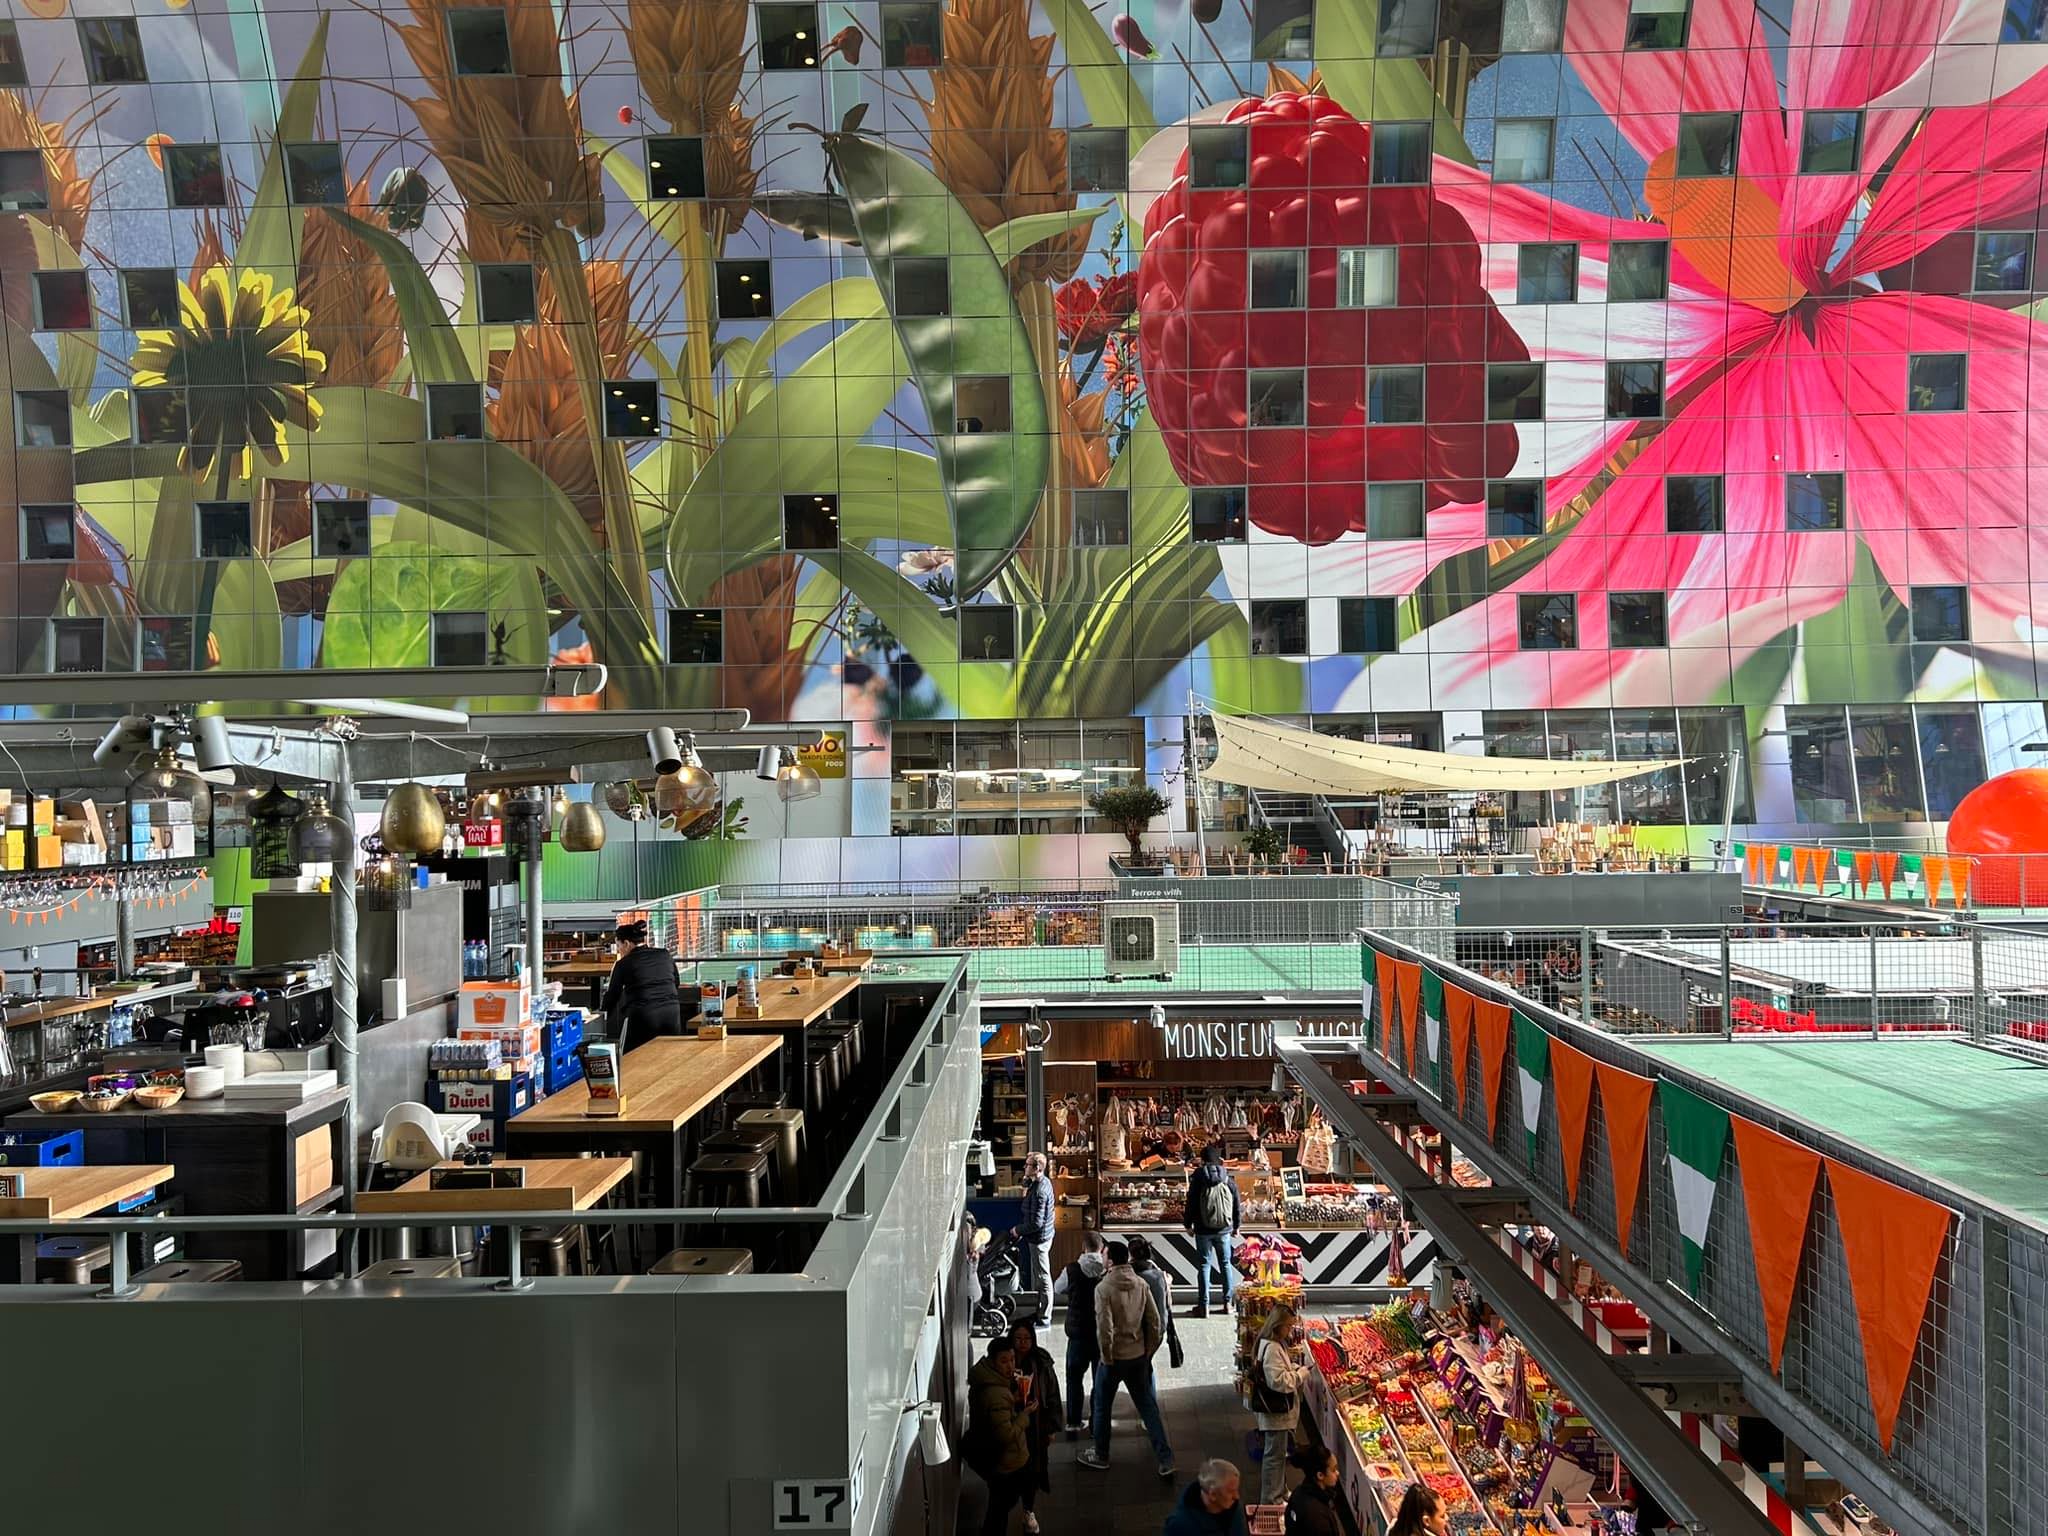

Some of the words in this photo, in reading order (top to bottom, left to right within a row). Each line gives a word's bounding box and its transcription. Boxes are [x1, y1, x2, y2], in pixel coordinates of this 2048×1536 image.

[1132, 888, 1162, 897] Terrace
[1165, 888, 1182, 897] with
[448, 1092, 491, 1108] Duvel
[778, 1486, 845, 1522] 17
